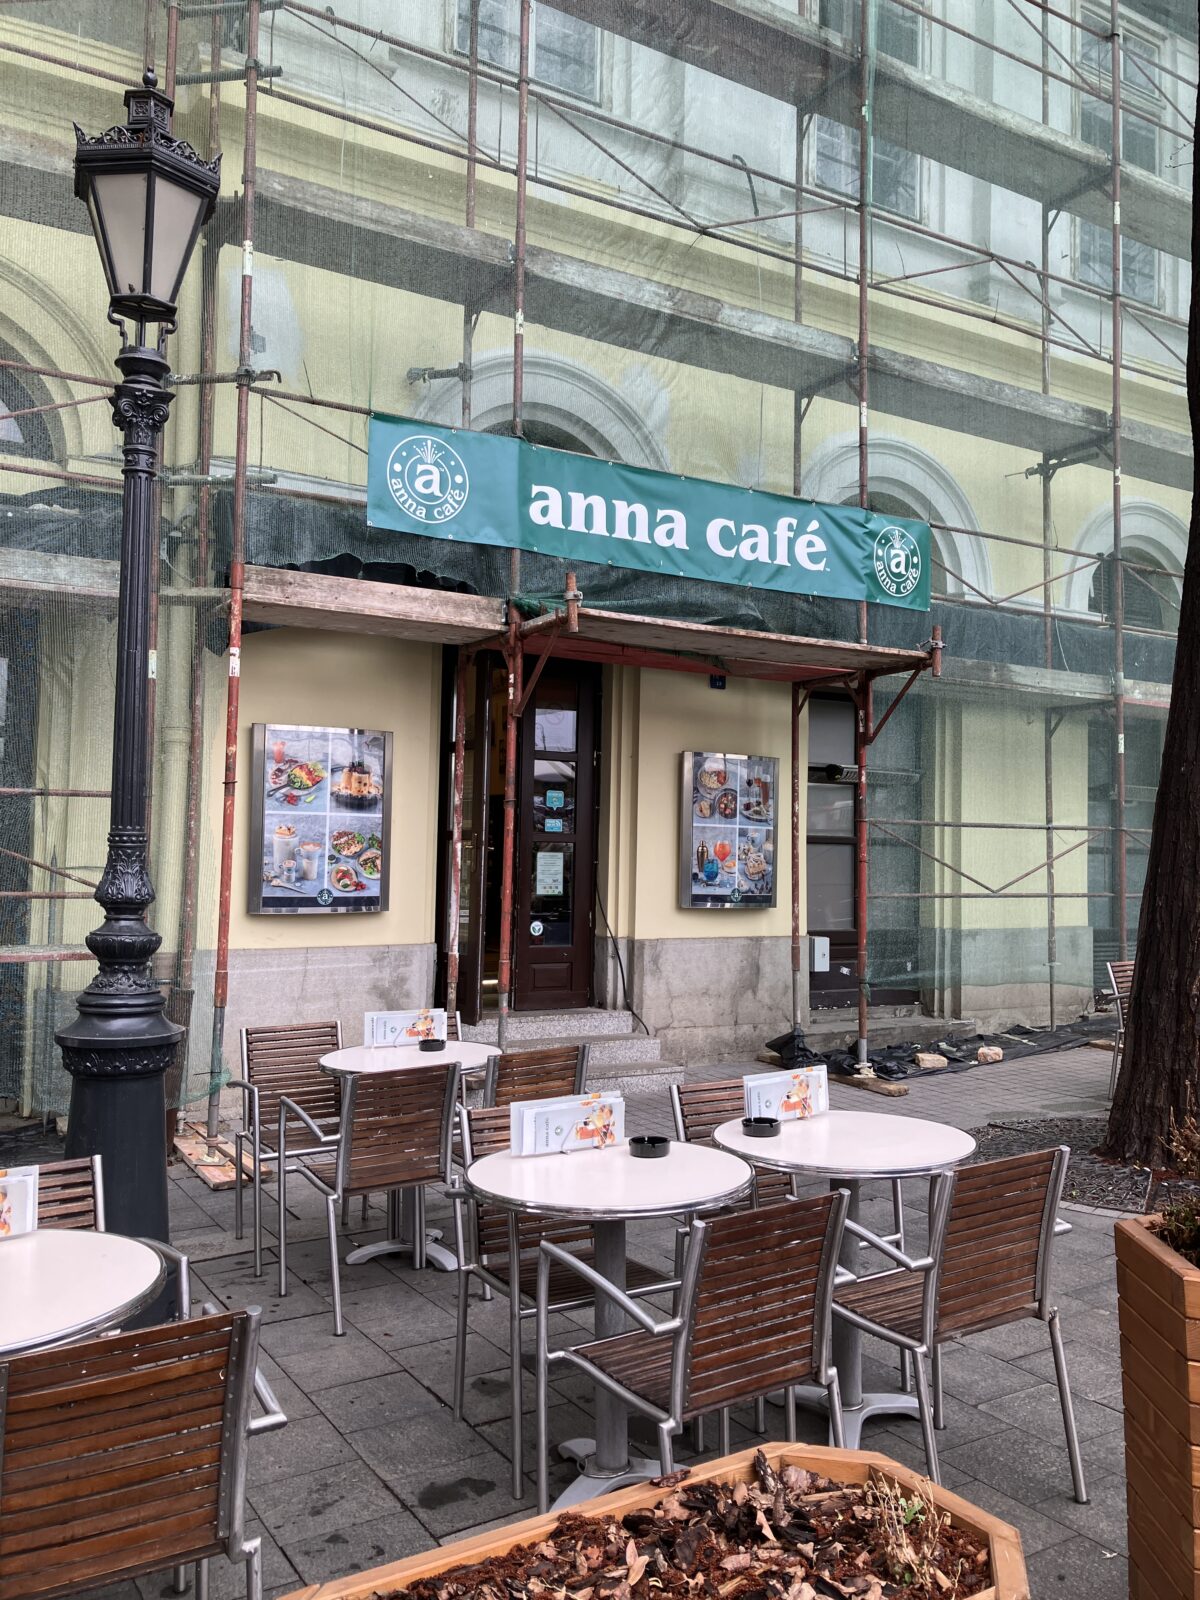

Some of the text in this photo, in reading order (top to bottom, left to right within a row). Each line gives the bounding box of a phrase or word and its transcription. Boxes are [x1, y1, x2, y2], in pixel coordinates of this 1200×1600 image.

[414, 463, 443, 497] a
[391, 478, 465, 519] anna café
[528, 484, 828, 572] anna café
[876, 561, 919, 594] anna café
[890, 548, 907, 575] a
